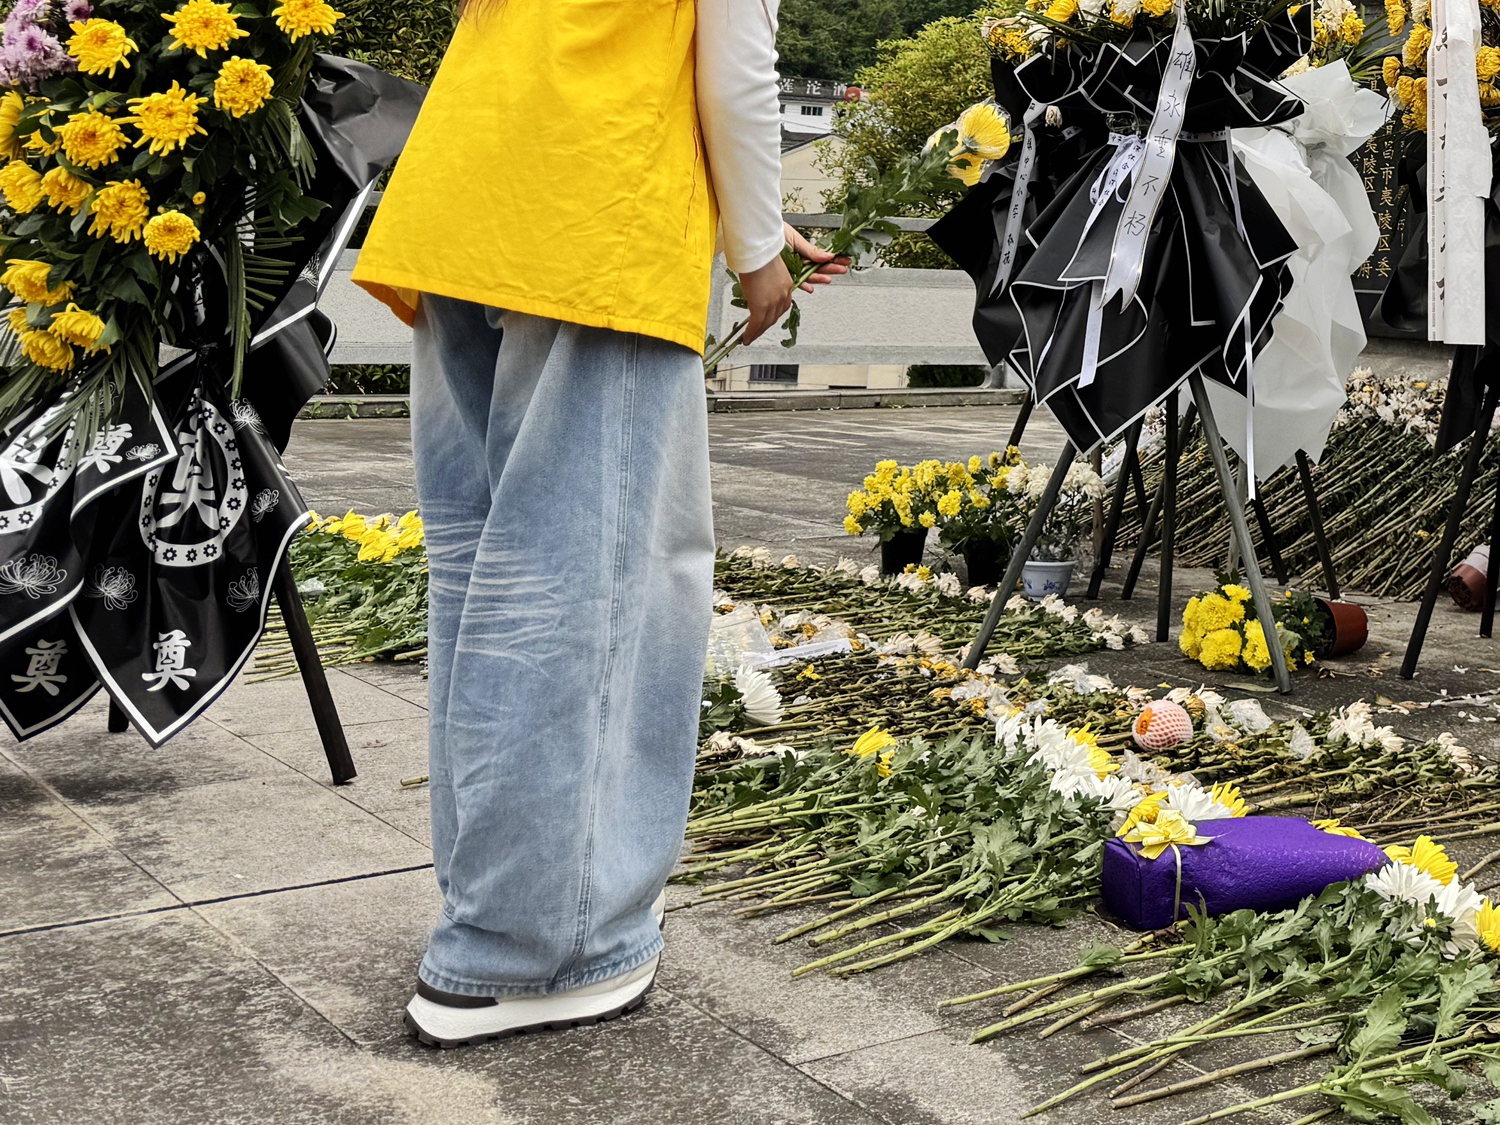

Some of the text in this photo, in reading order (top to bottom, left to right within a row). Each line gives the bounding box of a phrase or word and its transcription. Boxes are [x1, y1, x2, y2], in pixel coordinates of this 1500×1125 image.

[1123, 21, 1194, 239] 雄永垂不朽
[10, 638, 68, 697] 奠
[141, 628, 197, 693] 奠
